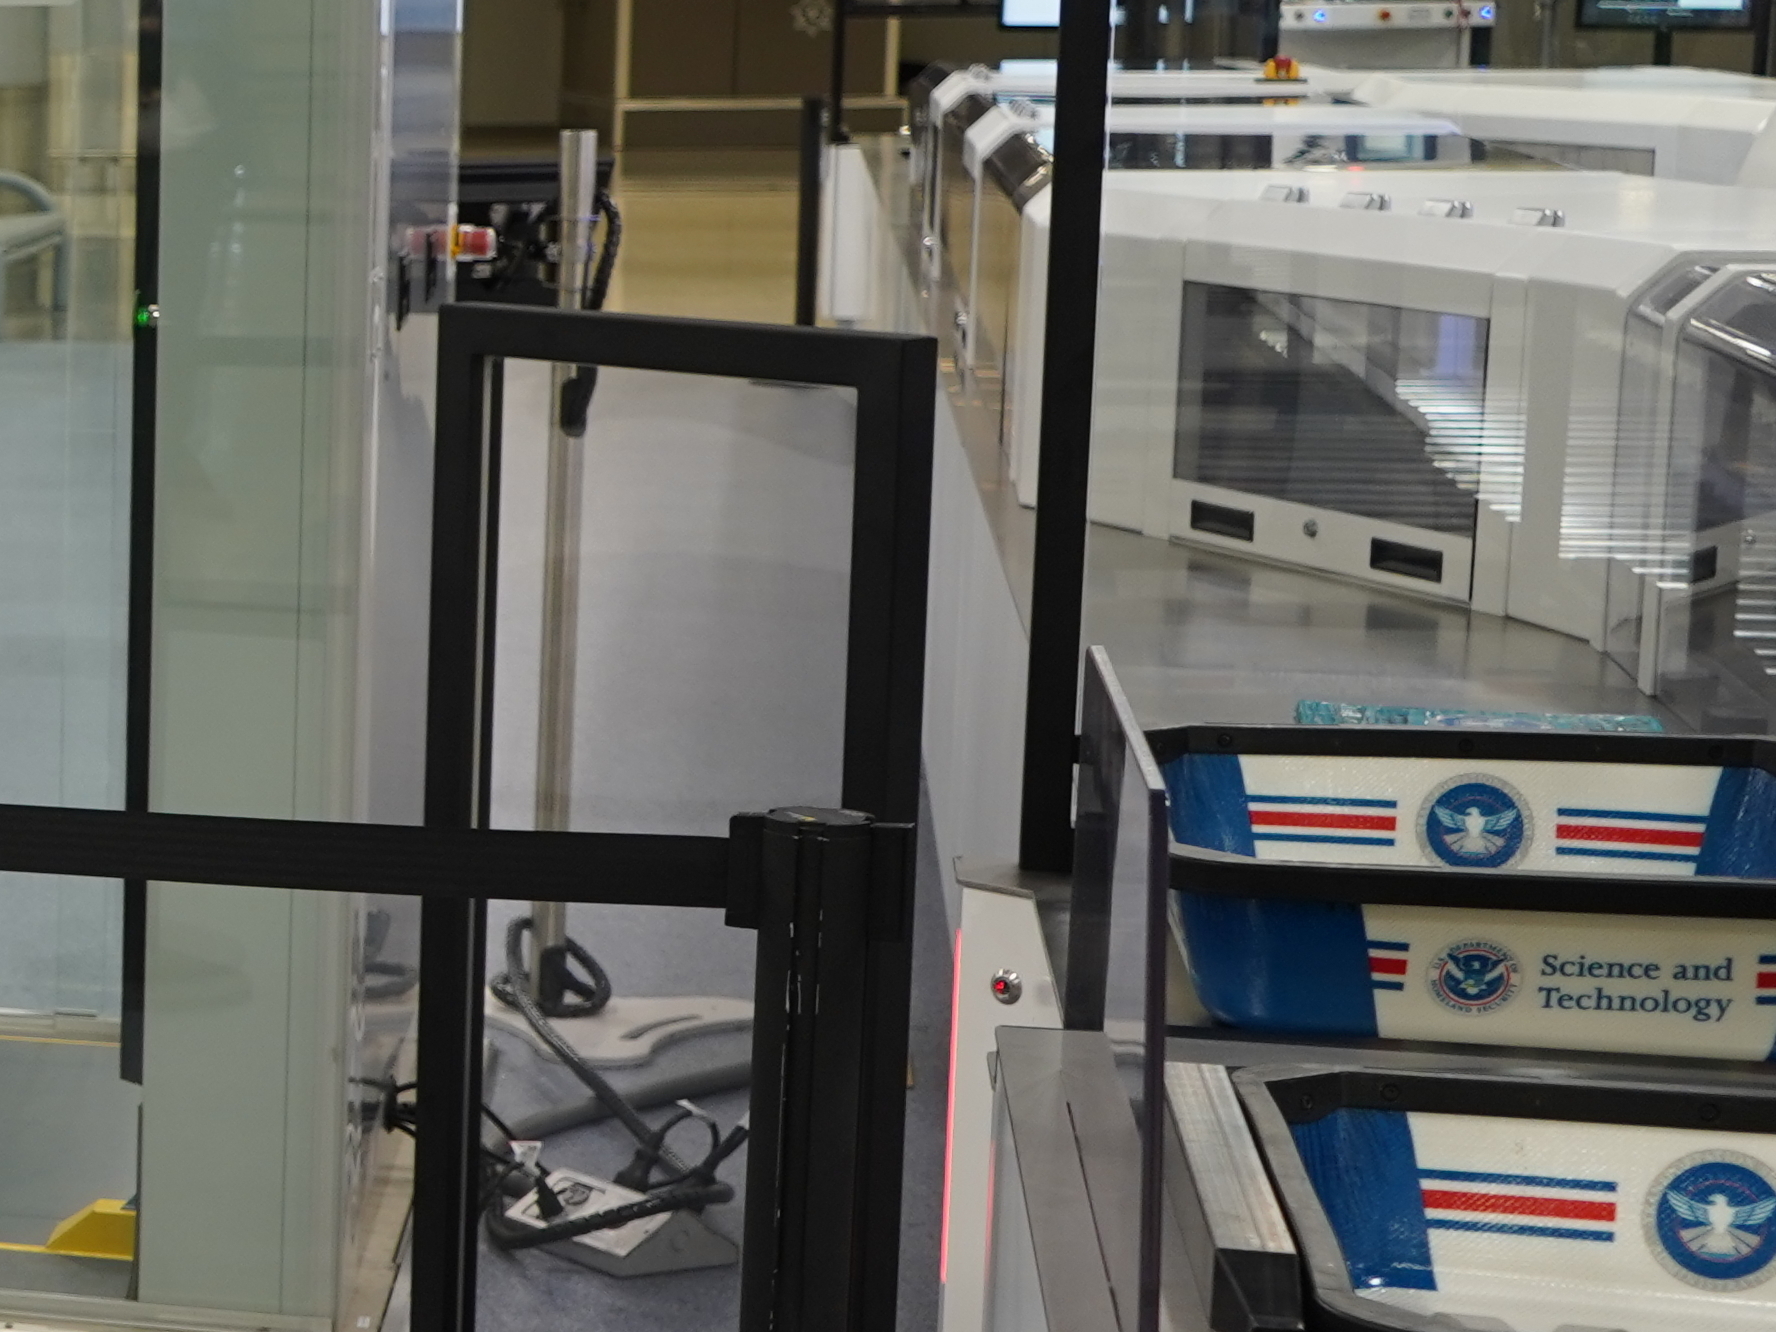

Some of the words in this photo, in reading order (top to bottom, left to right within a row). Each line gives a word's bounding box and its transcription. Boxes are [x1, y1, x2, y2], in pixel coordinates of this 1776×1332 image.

[1541, 954, 1661, 980] Science
[1673, 957, 1733, 982] and
[1538, 986, 1733, 1022] Technology
